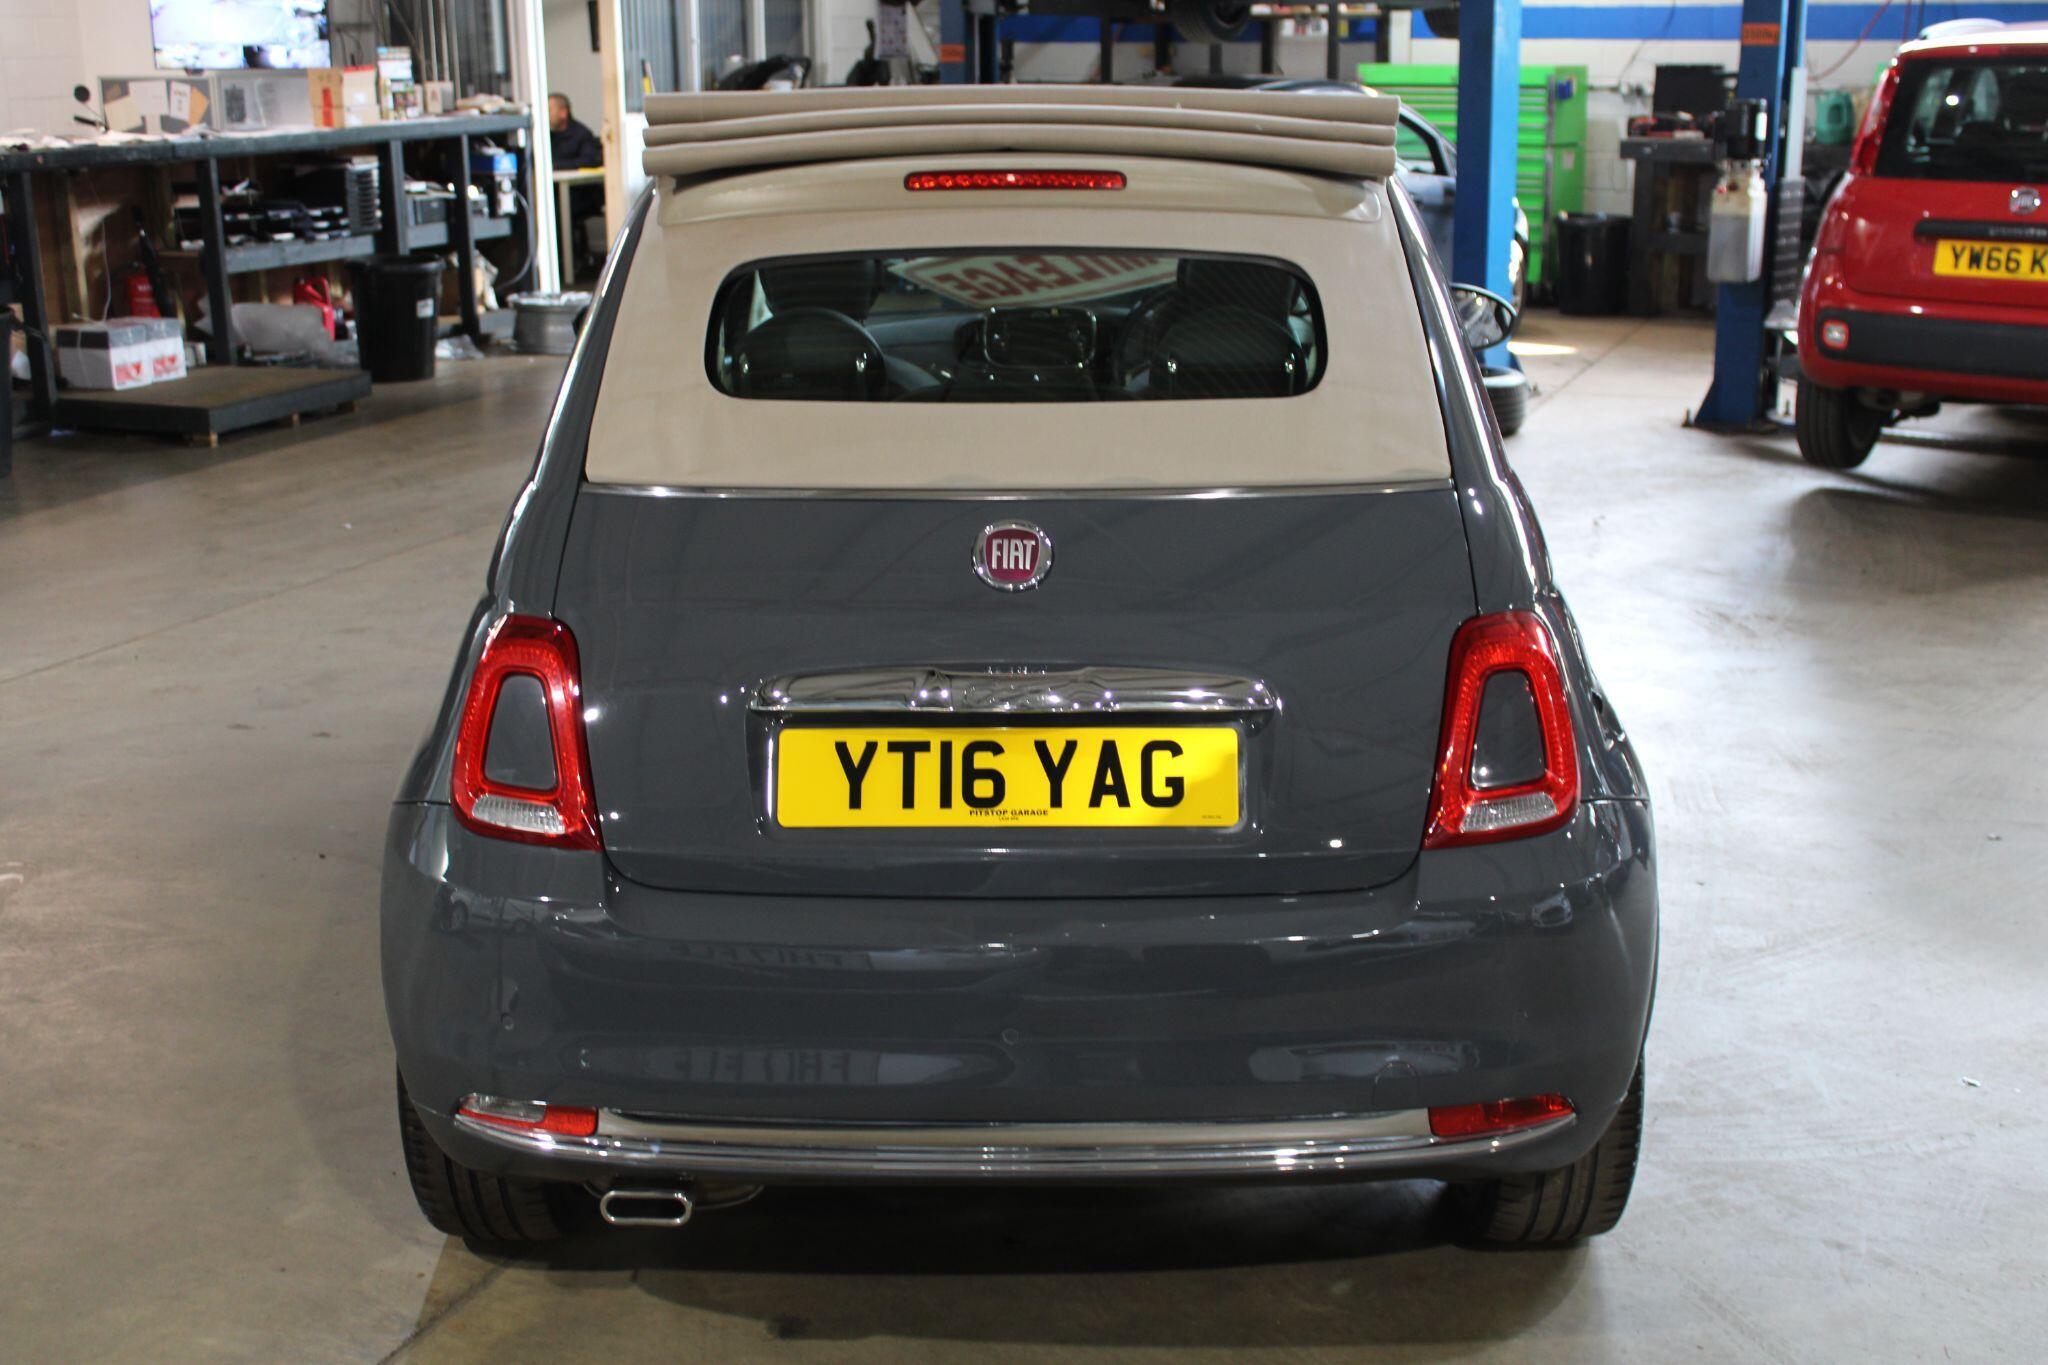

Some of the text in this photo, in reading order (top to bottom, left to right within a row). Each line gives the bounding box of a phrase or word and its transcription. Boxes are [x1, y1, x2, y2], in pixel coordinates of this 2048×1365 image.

[1951, 245, 2021, 273] YW66
[991, 538, 1036, 571] FIAT
[834, 739, 1185, 809] YT16 YAG
[969, 809, 1008, 817] PITSTOP
